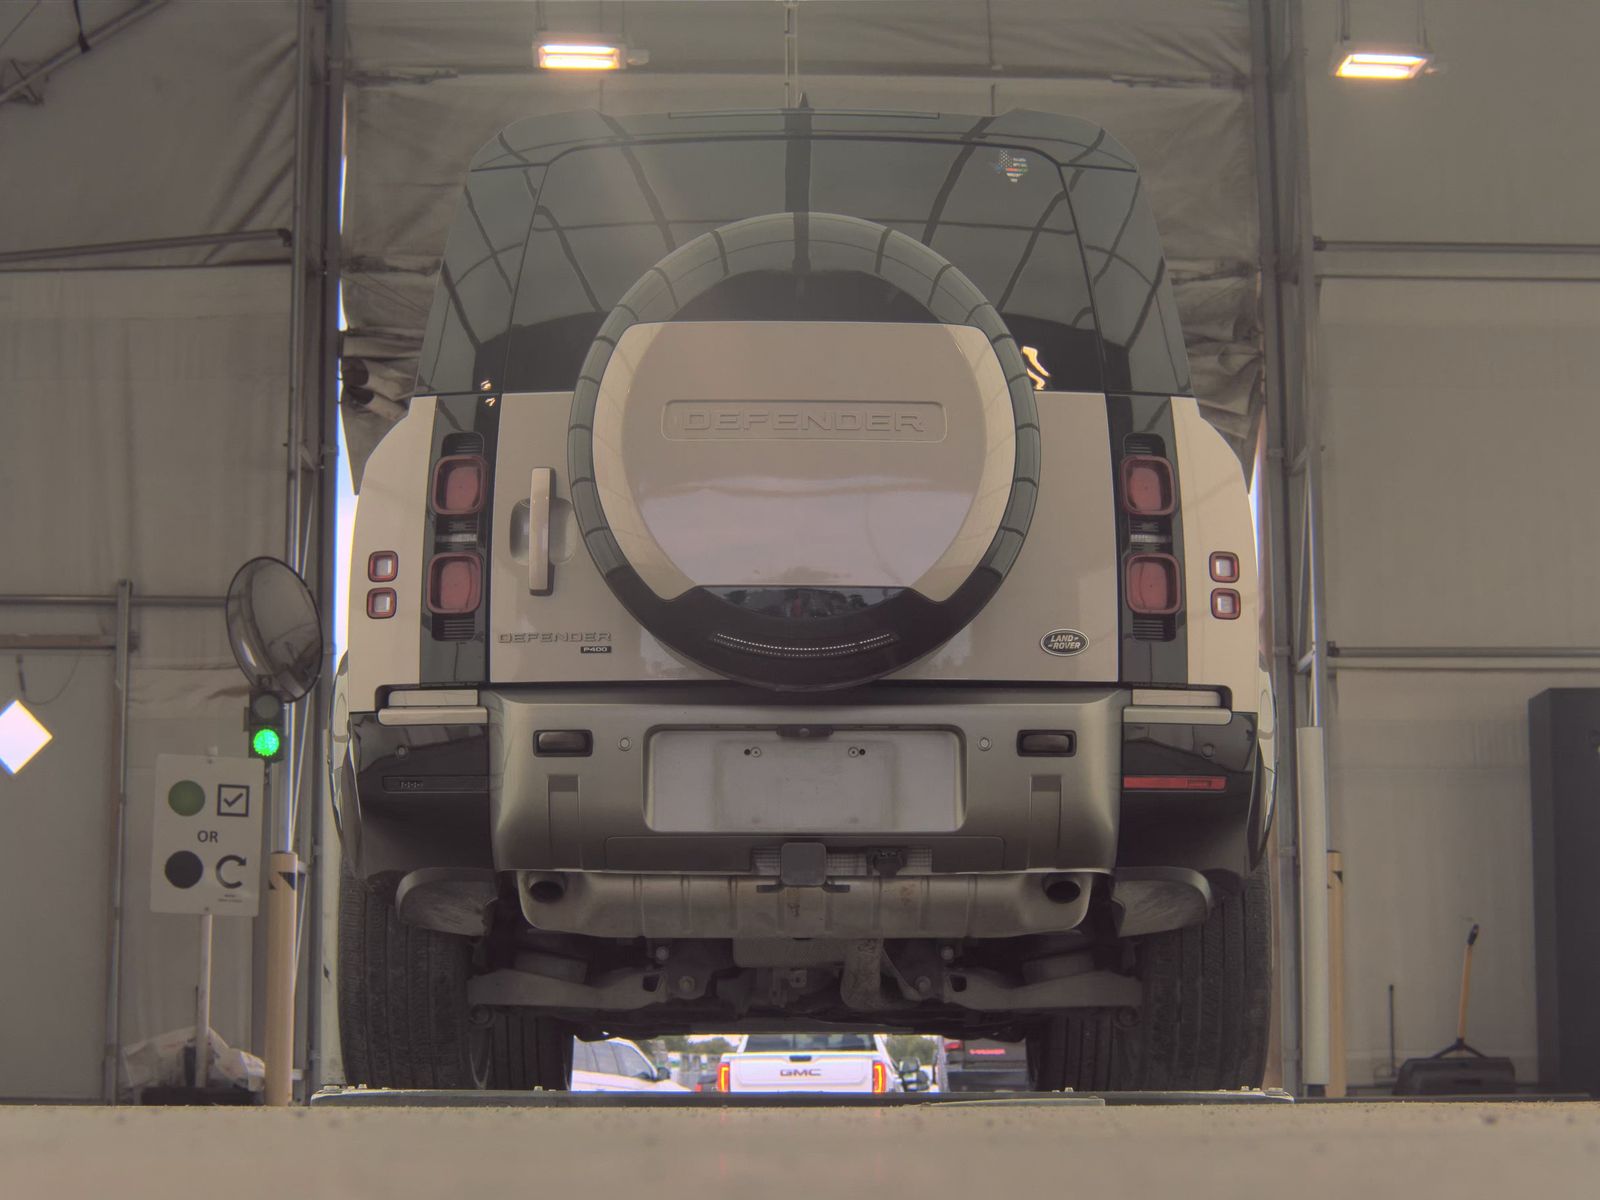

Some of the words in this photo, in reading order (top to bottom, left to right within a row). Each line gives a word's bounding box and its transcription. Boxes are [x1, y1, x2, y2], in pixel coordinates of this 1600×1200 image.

[684, 410, 926, 432] DEFENDER
[499, 631, 612, 643] DEFENDER
[197, 830, 218, 843] OR
[779, 1068, 821, 1077] GMC
